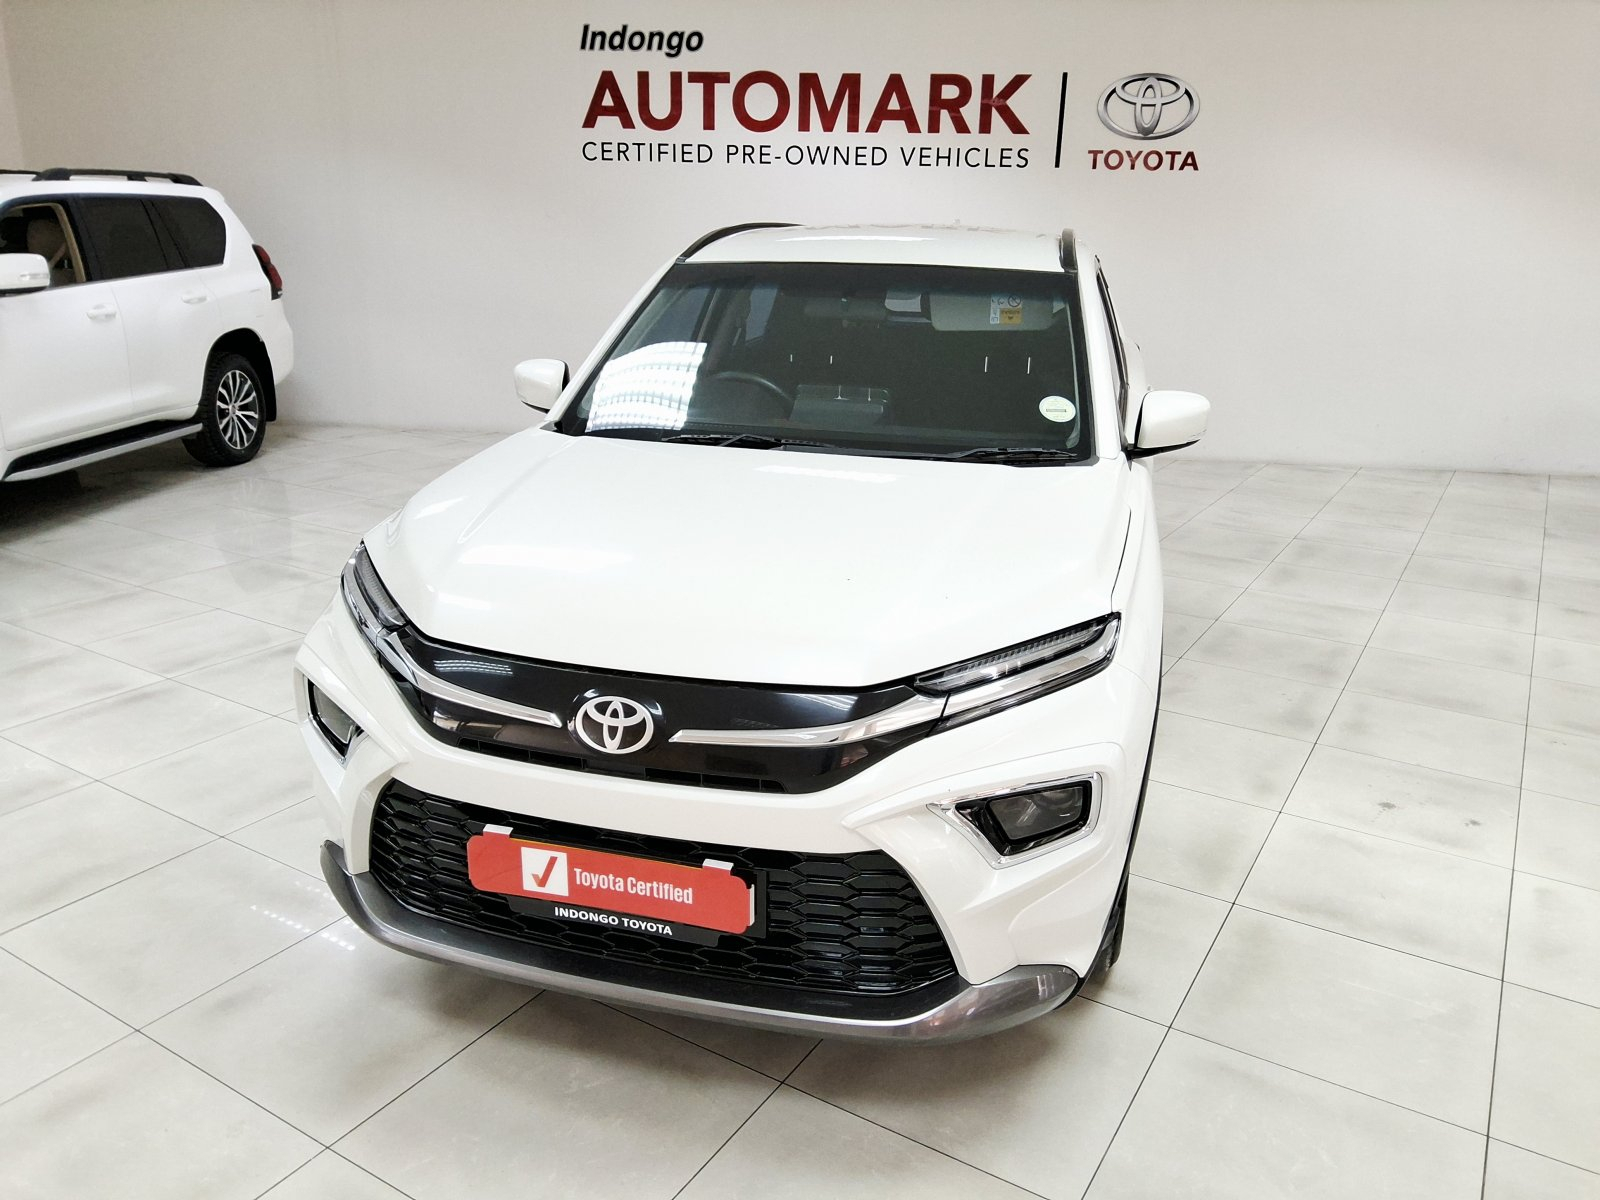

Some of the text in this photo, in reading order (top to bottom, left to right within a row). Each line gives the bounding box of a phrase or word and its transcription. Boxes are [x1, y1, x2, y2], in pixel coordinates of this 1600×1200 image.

[580, 24, 704, 58] Indongo
[582, 70, 1032, 134] AUTOMARK
[582, 142, 1029, 169] CERTIFIED PRE-OWNED VEHICLES
[1088, 150, 1199, 171] TOYOTA
[574, 868, 693, 904] Toyota Certified
[554, 907, 673, 935] INDONGO TOYOTA
